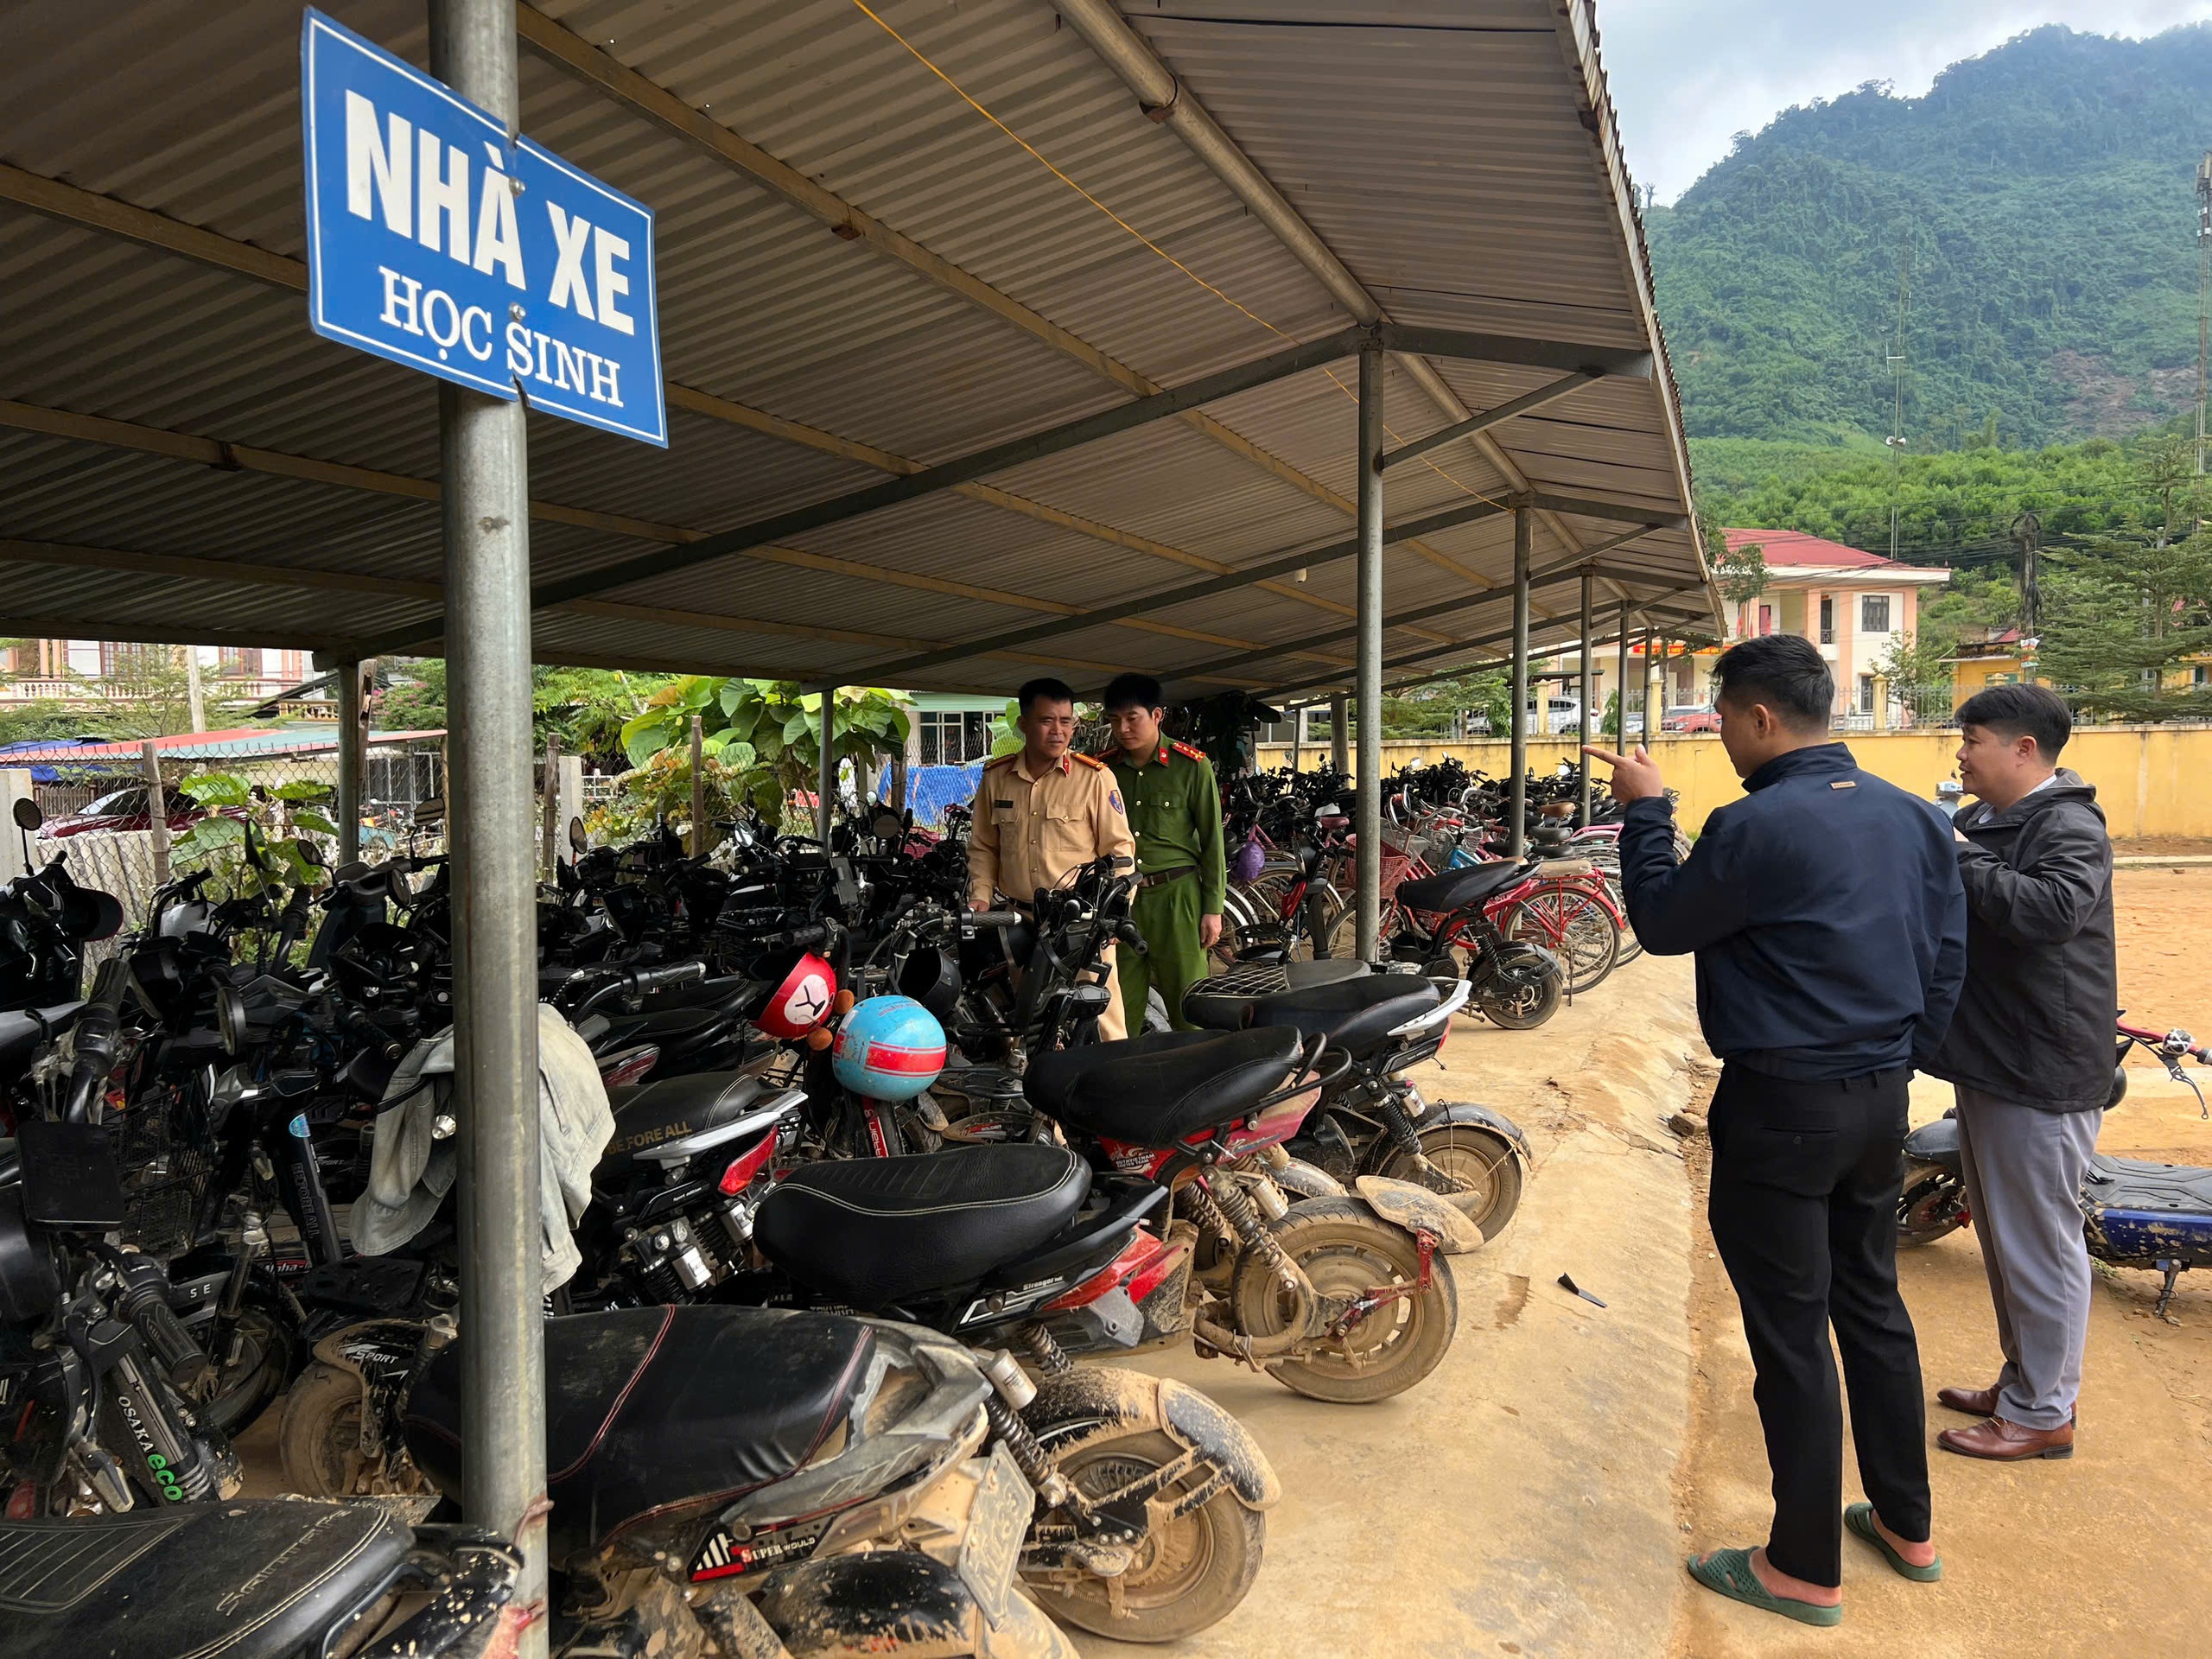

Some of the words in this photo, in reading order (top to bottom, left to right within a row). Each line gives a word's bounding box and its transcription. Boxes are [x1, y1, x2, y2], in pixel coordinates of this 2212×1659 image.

[346, 89, 526, 290] NHÀ
[546, 200, 634, 336] XE
[378, 265, 493, 360] HỌC
[505, 321, 624, 408] SINH
[665, 1121, 693, 1139] ALL
[352, 1349, 399, 1364] SPORT
[118, 1395, 155, 1452] OSAKA
[147, 1453, 183, 1501] eco
[740, 1544, 783, 1563] SUPER
